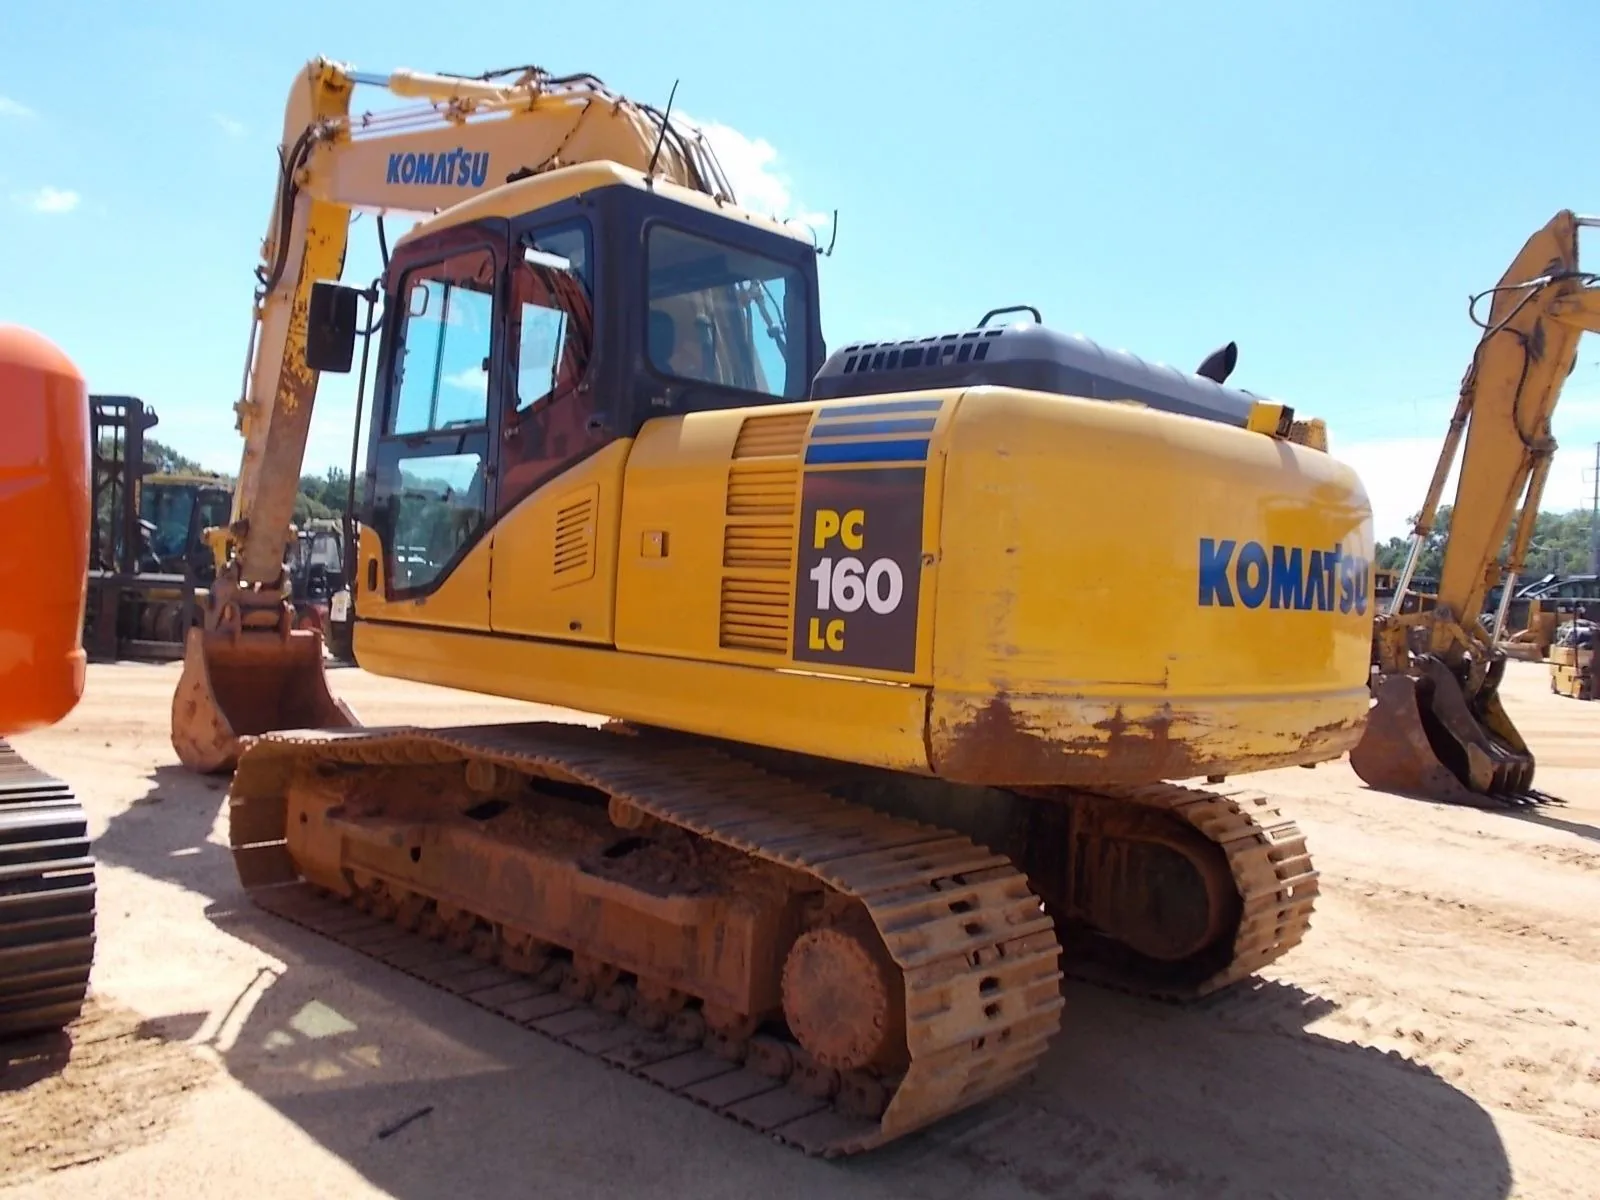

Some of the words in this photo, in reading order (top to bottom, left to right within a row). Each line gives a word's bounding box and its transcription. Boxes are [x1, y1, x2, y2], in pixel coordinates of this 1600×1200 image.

[386, 147, 489, 187] KOMATSU
[814, 509, 865, 550] PC
[809, 556, 903, 615] 160
[1198, 538, 1369, 616] KOMATSU
[808, 617, 845, 651] LC
